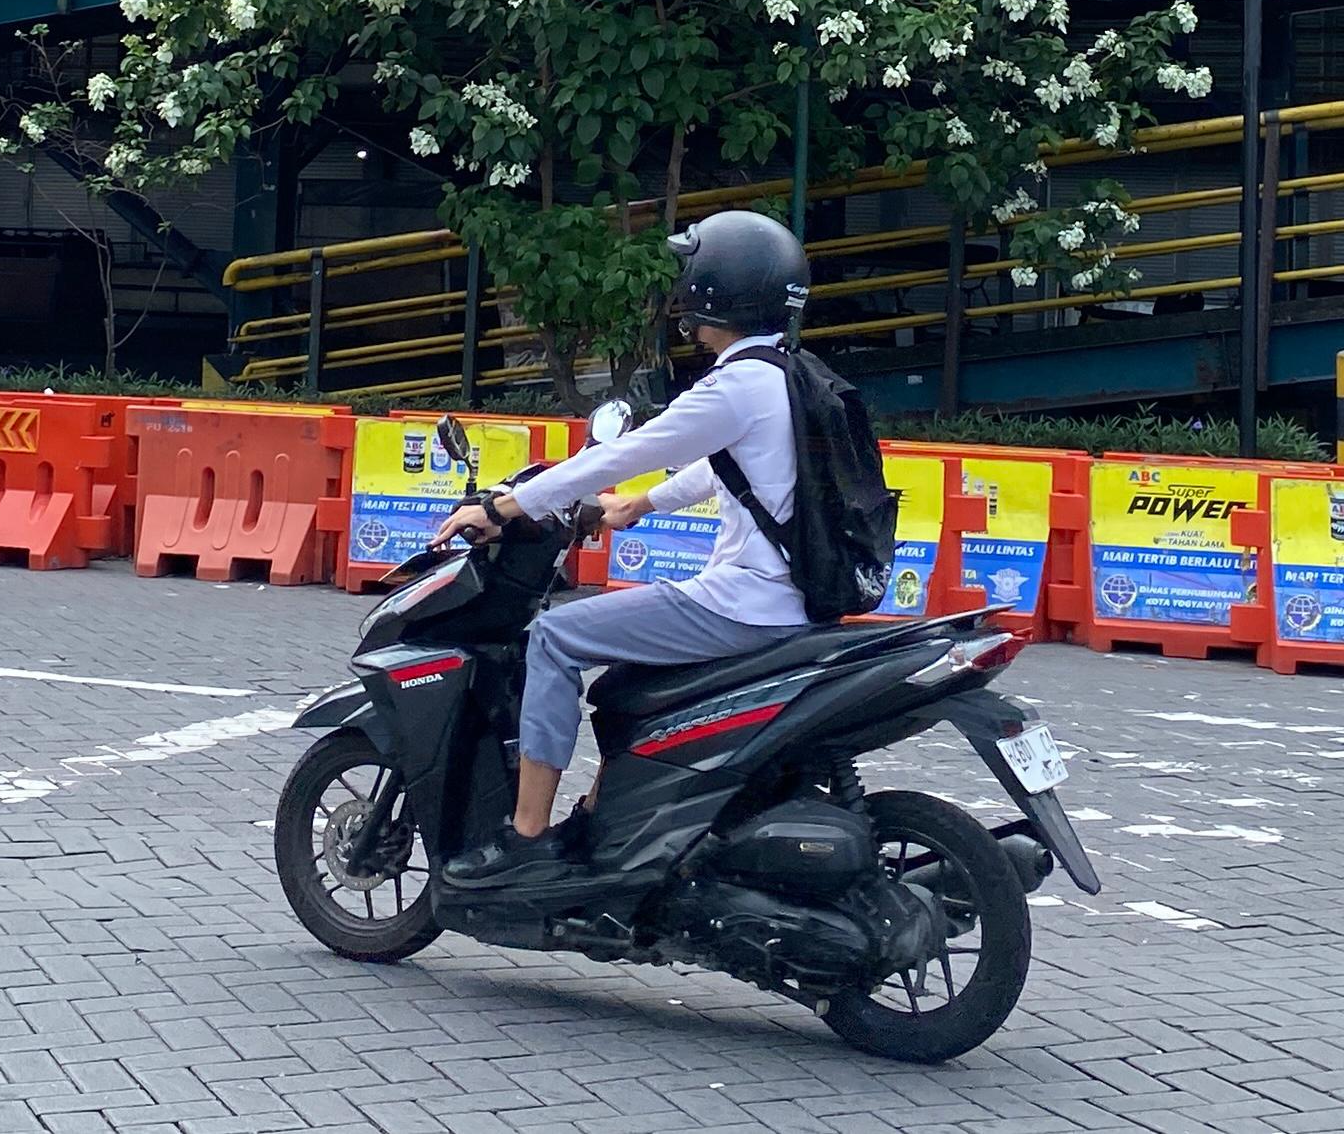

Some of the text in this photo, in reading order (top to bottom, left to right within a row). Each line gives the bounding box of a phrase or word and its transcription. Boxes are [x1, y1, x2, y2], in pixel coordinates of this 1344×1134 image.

[1129, 470, 1161, 482] ABC
[1167, 484, 1216, 498] Super
[362, 500, 390, 509] MARI
[652, 519, 688, 531] TERTIB
[689, 522, 721, 534] BERLA
[1168, 538, 1197, 546] TAHAN
[1200, 540, 1225, 548] LAMA
[649, 549, 676, 558] DINAS
[996, 544, 1035, 556] LINTAS
[654, 560, 676, 569] KOTA
[1102, 551, 1134, 562] MARI
[1137, 553, 1177, 565] TERTIB
[1180, 556, 1232, 569] BERLALU
[1139, 586, 1242, 599] DINAS PERHUBUNGAN
[1145, 598, 1170, 606] KOTA
[400, 673, 444, 689] HONDA
